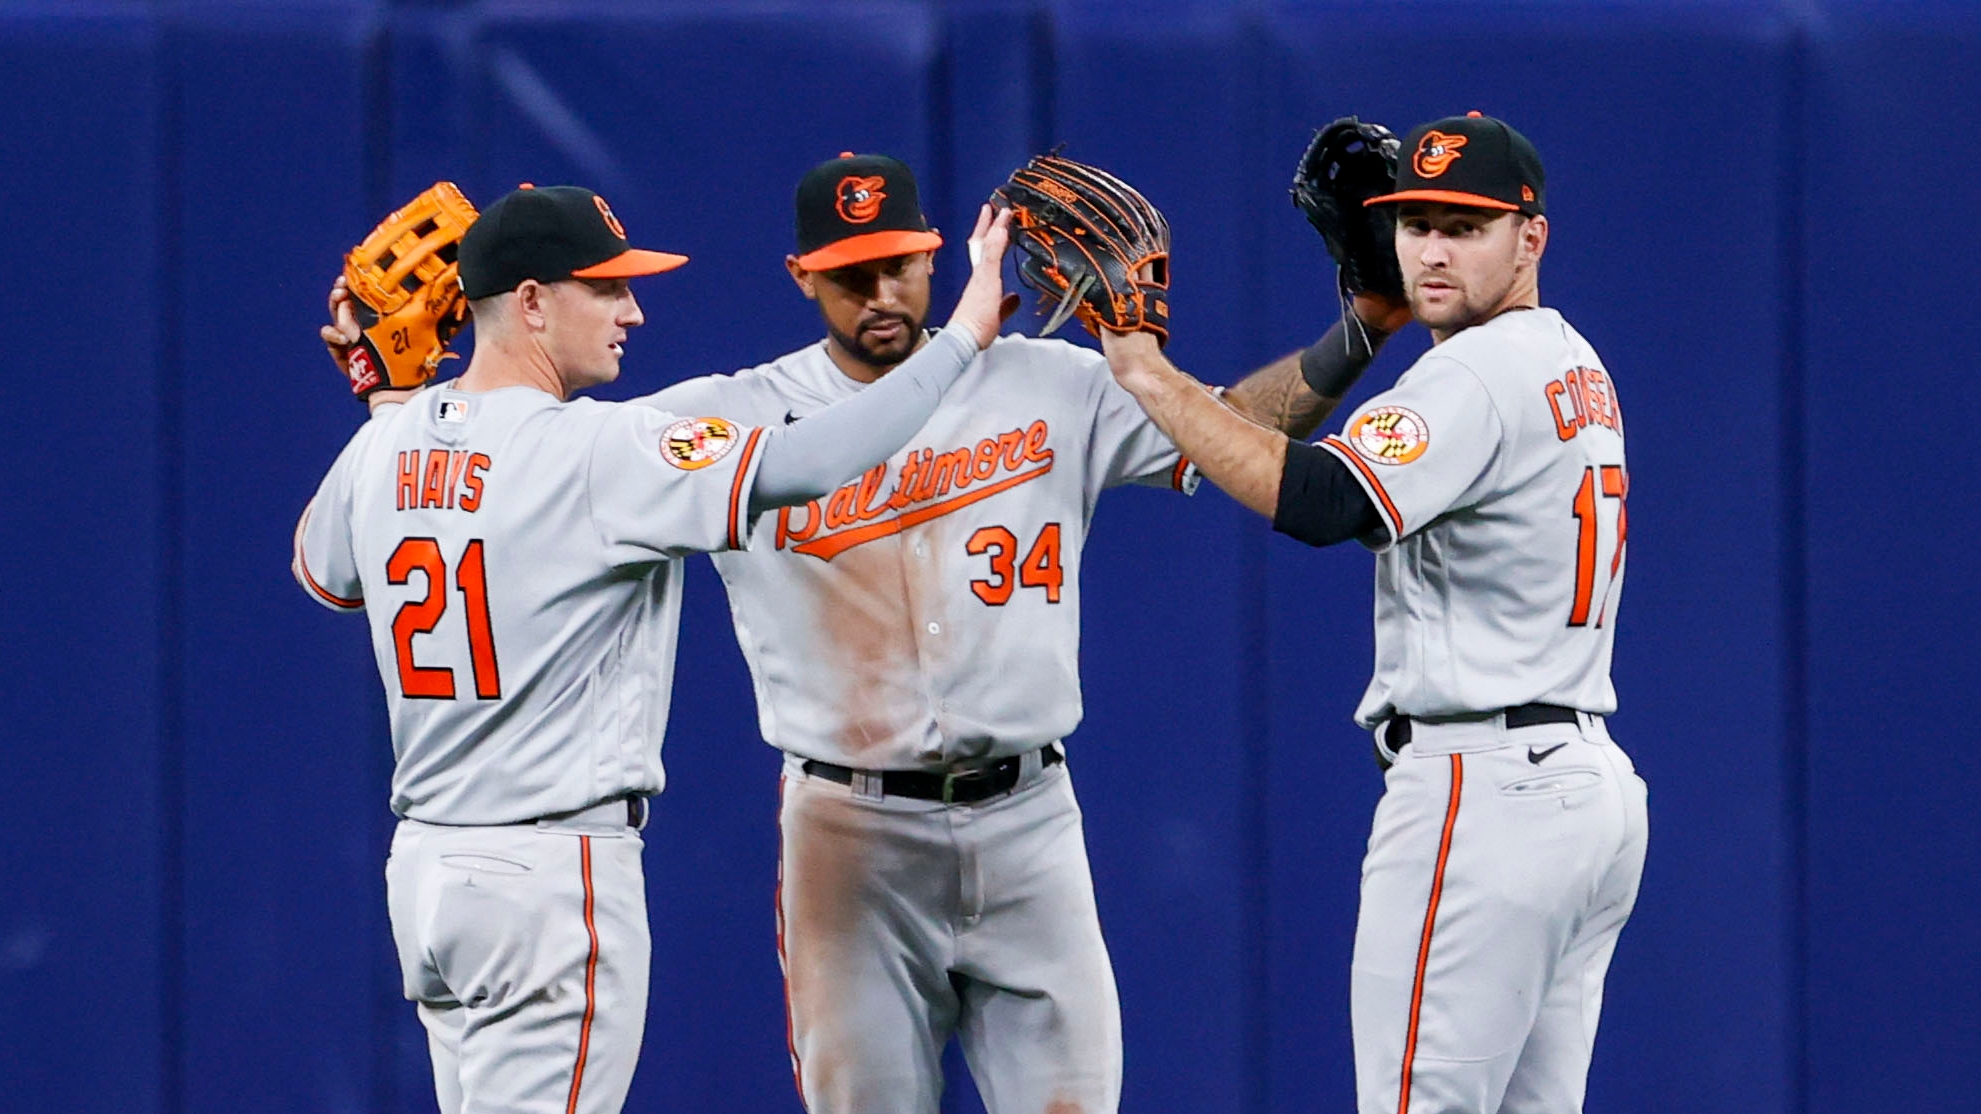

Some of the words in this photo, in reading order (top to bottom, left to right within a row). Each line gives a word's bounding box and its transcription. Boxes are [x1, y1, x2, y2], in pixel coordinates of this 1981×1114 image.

[391, 326, 411, 355] 21
[396, 449, 492, 513] HAYS
[966, 522, 1063, 606] 34
[1566, 464, 1629, 629] 17
[385, 536, 502, 701] 21
